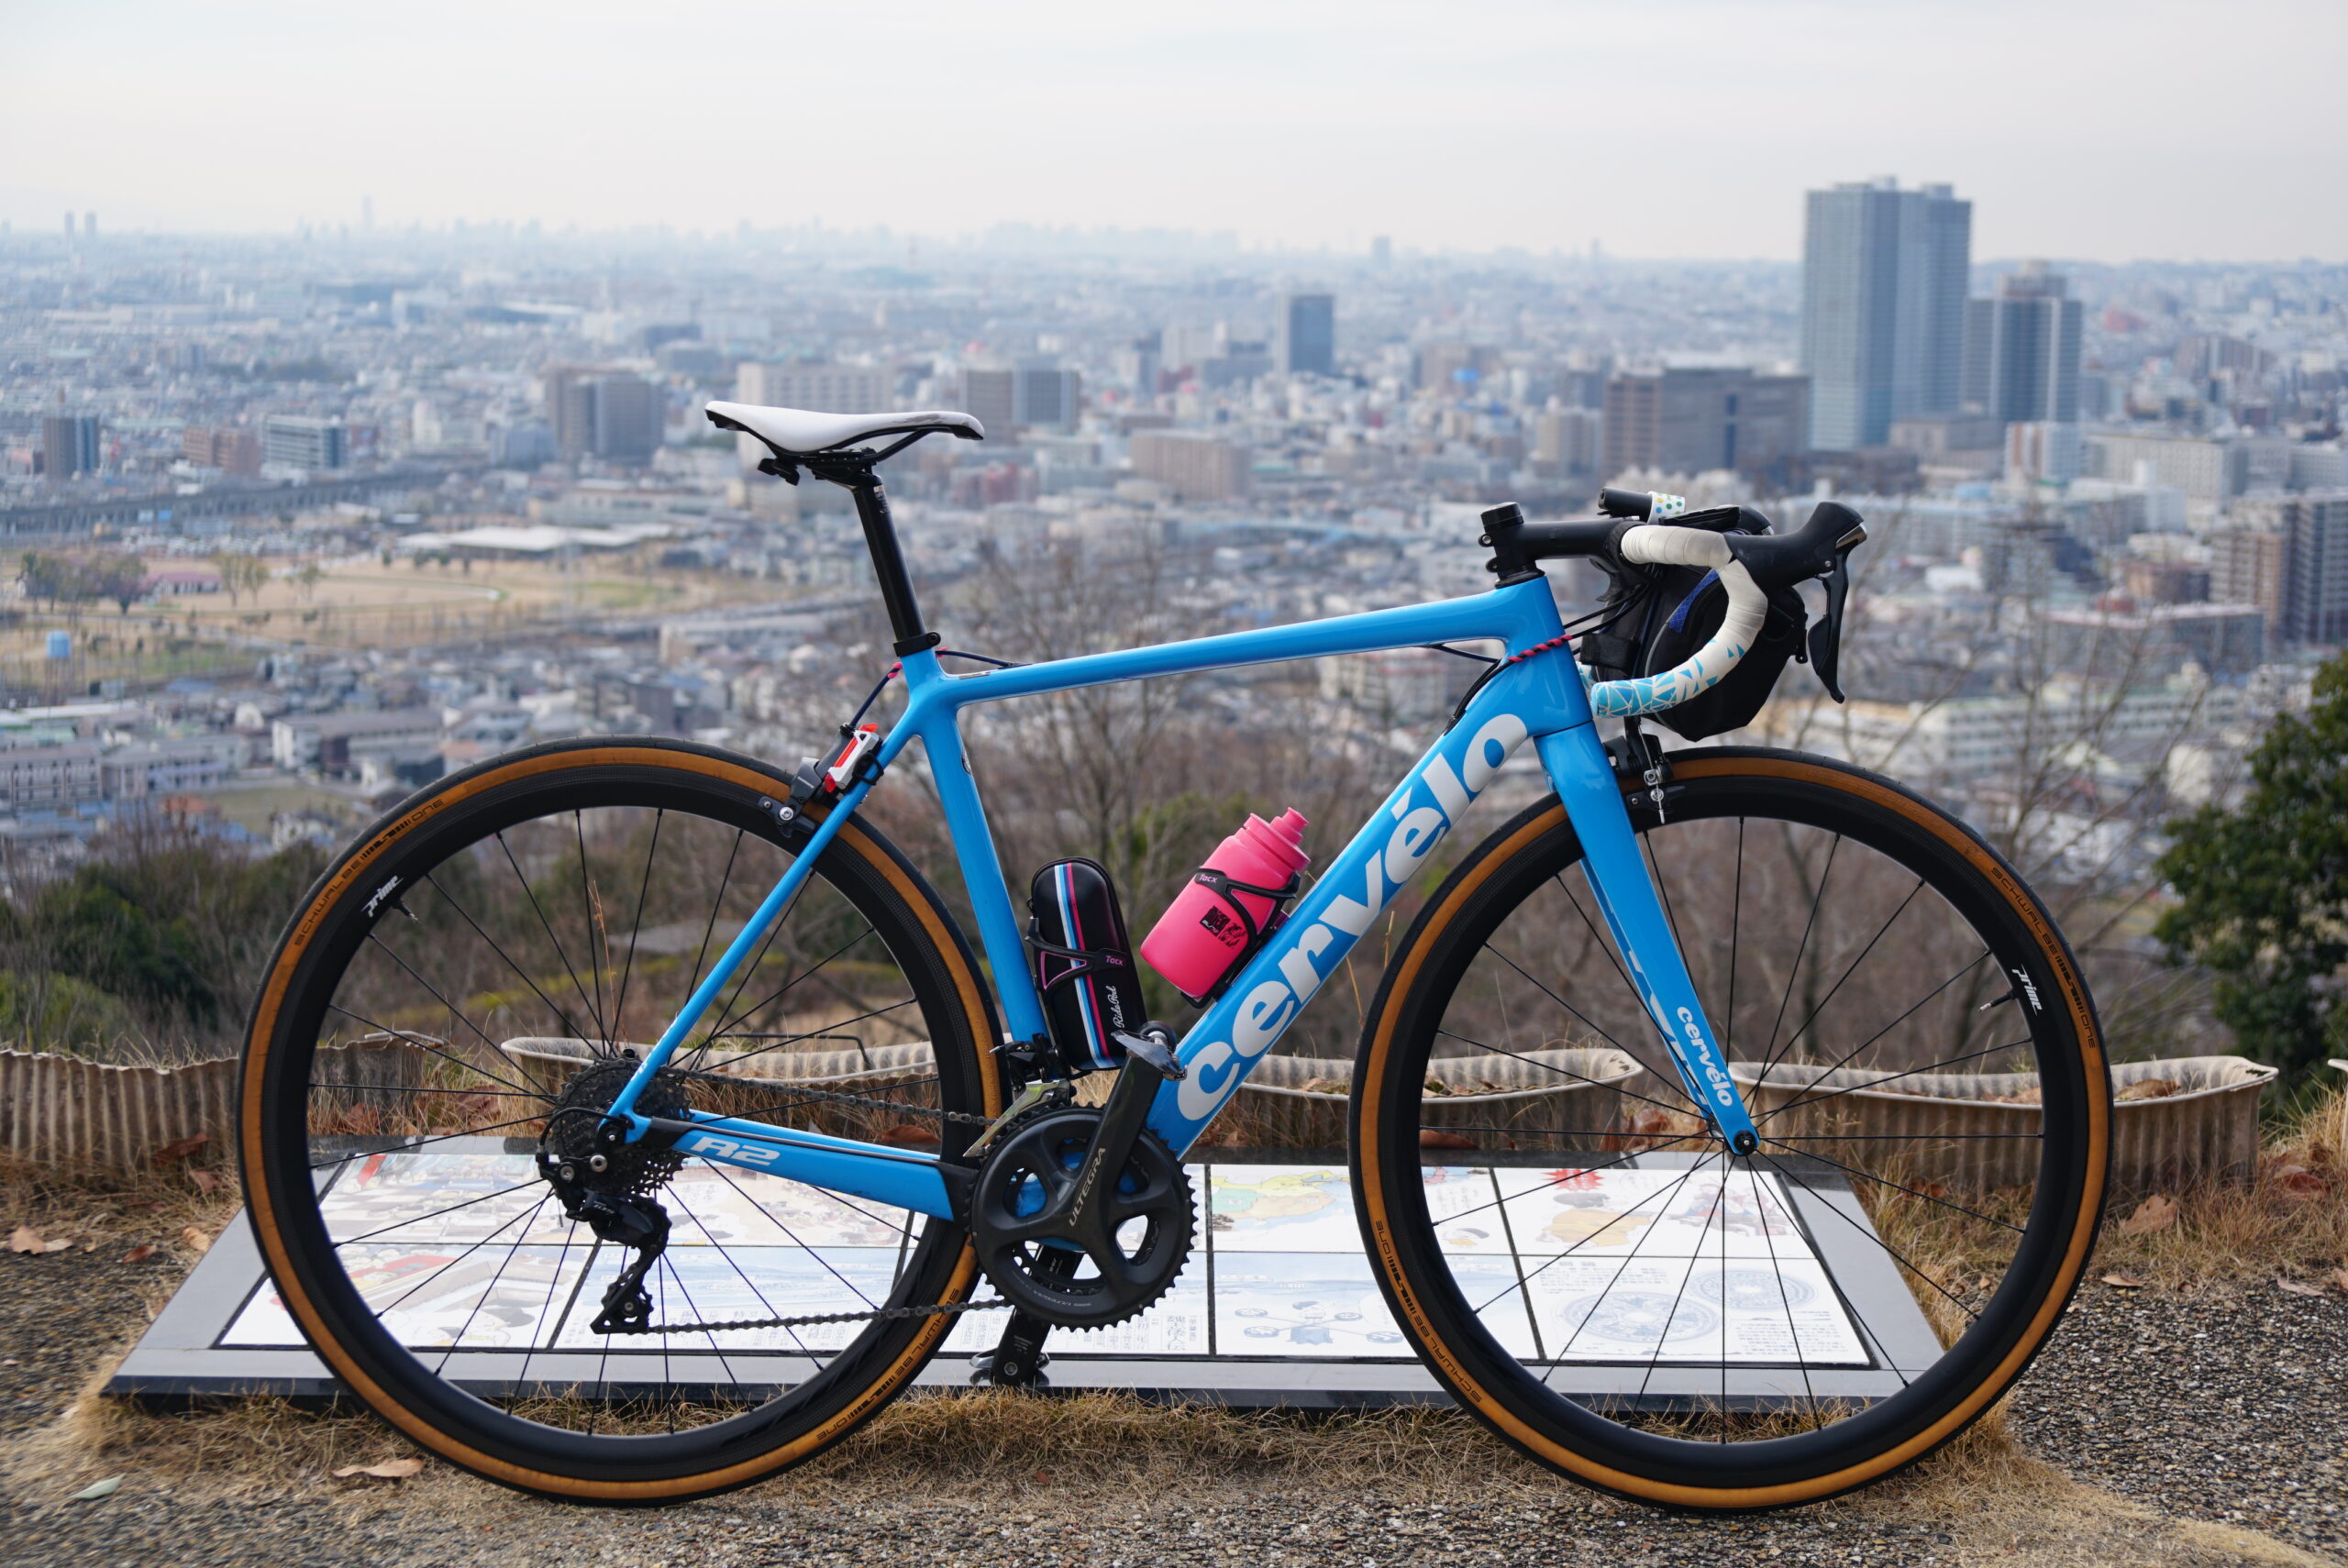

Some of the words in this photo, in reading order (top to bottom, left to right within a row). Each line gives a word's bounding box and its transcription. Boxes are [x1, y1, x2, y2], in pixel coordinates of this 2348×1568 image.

[294, 858, 361, 947] SCHWALBE
[1177, 713, 1528, 1121] cervélo
[1199, 874, 1218, 884] Tacx
[1990, 867, 2058, 955] SCHWALBE
[1105, 955, 1124, 966] Tacx
[1677, 1006, 1733, 1107] cervélo
[690, 1136, 781, 1166] R2
[1069, 1147, 1106, 1227] ULTEGRA
[894, 1288, 959, 1376] SHWALBE
[1413, 1314, 1483, 1404] SCHWALBE
